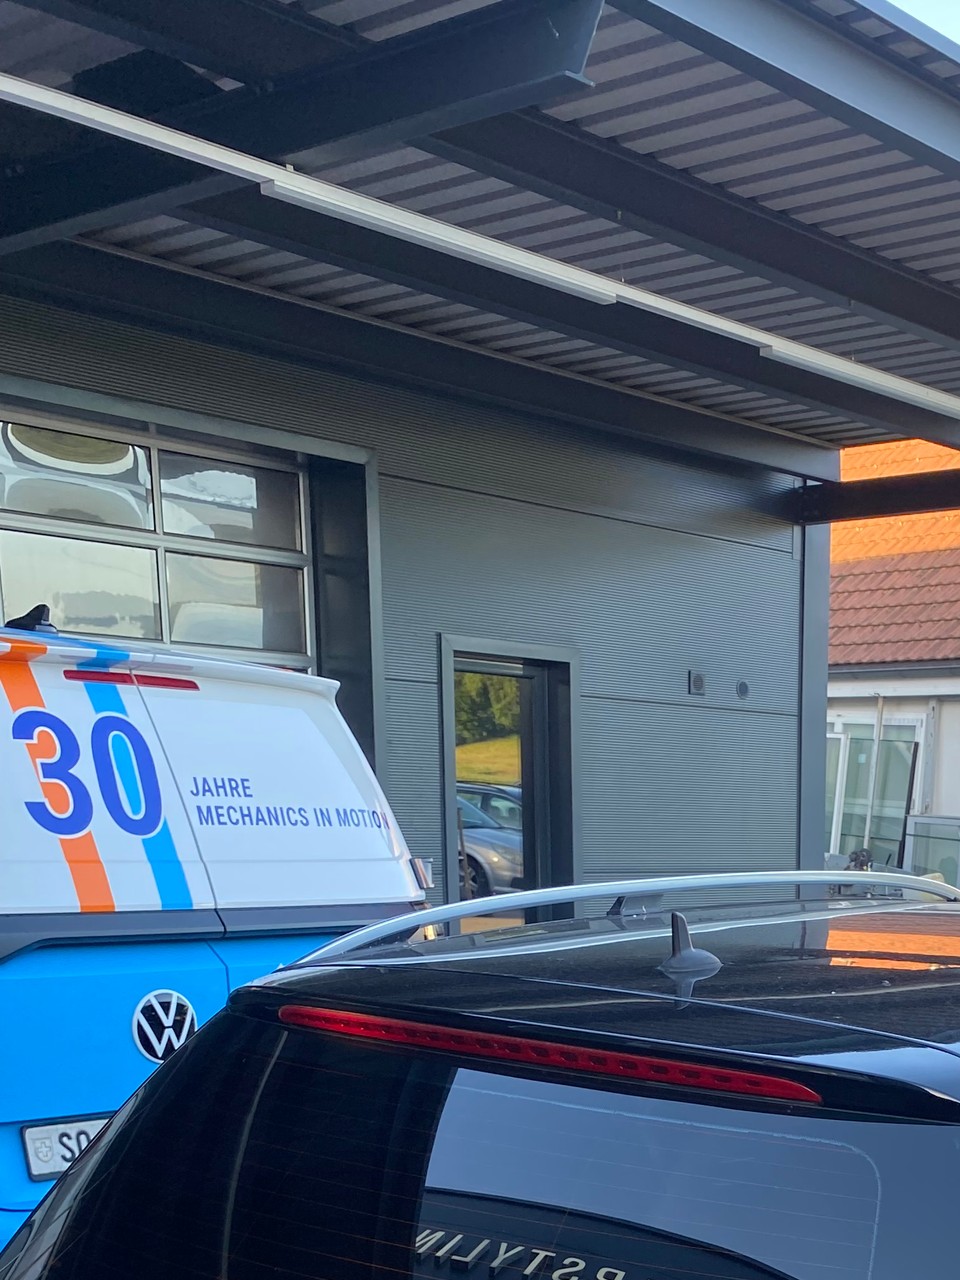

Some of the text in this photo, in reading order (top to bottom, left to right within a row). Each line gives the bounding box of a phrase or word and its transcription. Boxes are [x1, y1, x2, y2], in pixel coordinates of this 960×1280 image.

[11, 709, 163, 836] 30
[190, 776, 253, 798] JAHRE
[196, 804, 391, 830] MECHANICS IN MOTION
